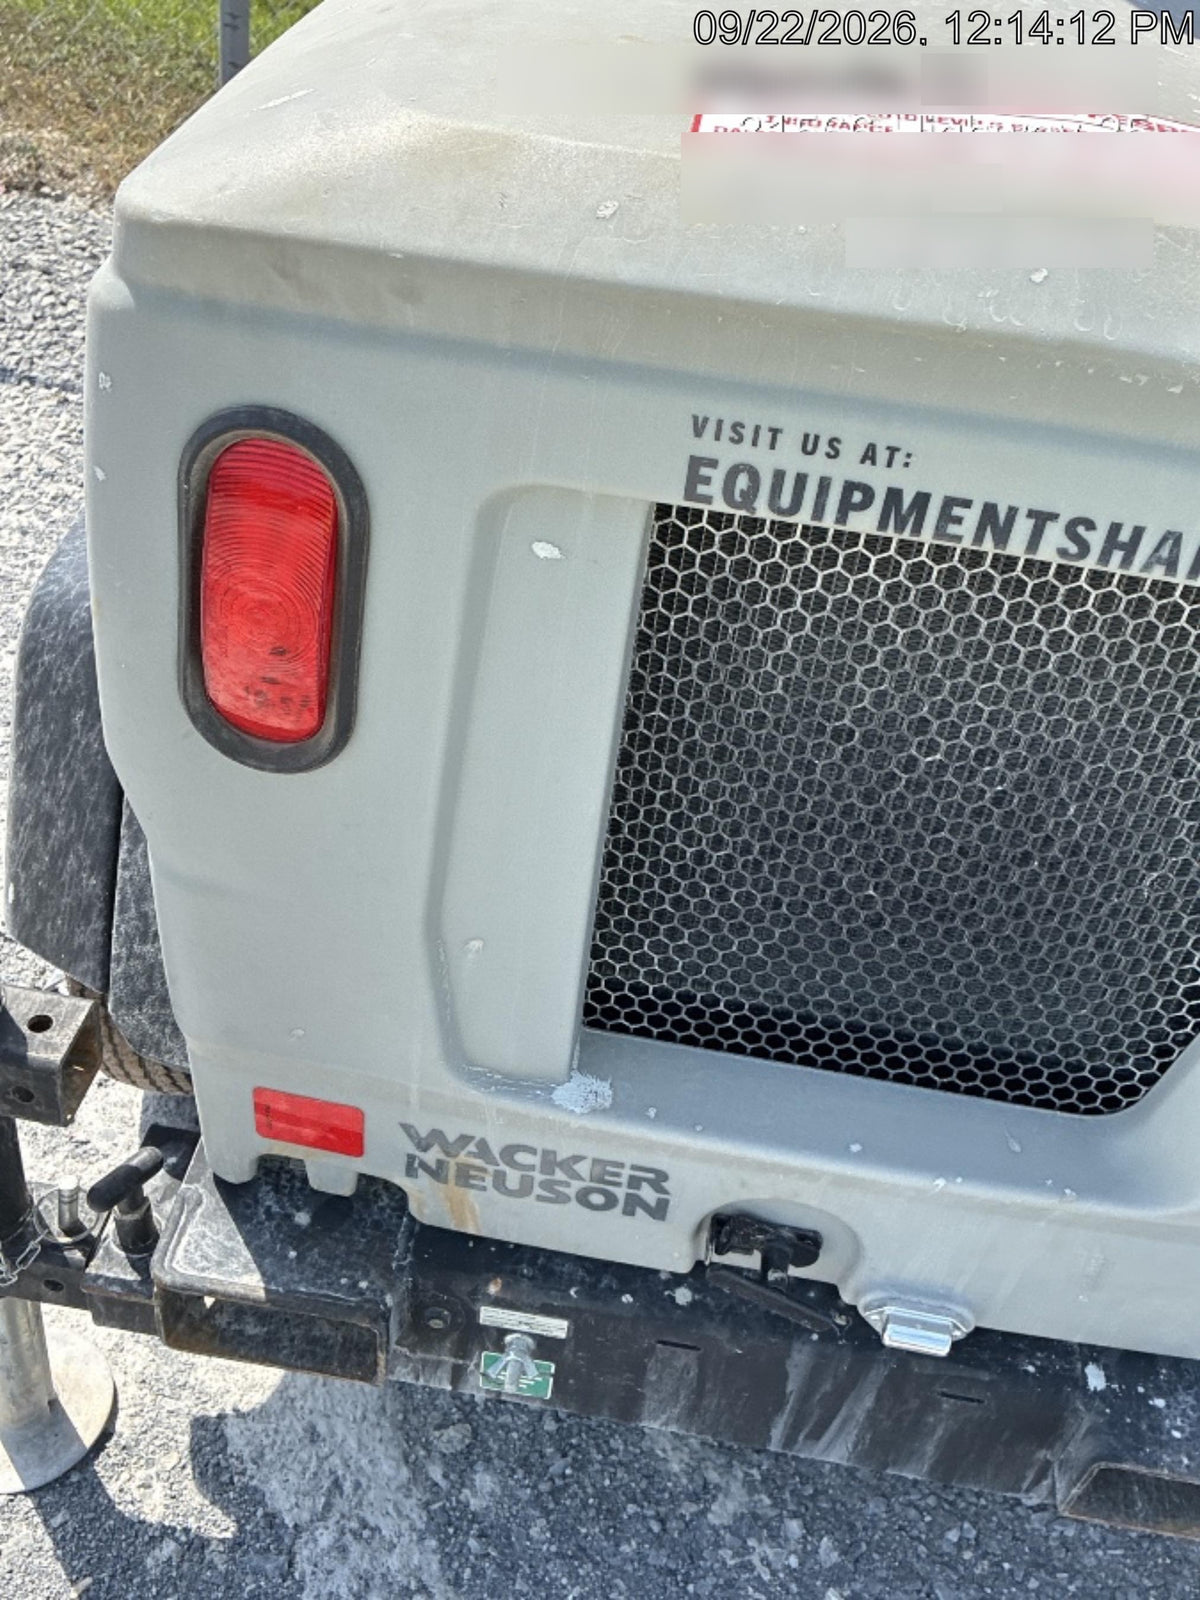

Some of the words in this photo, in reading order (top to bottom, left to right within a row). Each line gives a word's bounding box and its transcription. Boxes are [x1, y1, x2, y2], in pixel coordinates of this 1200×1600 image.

[691, 414, 783, 451] VISIT
[801, 432, 842, 460] US
[859, 442, 914, 469] AT:
[398, 1121, 671, 1196] WACKER
[405, 1152, 671, 1222] NEUSON
